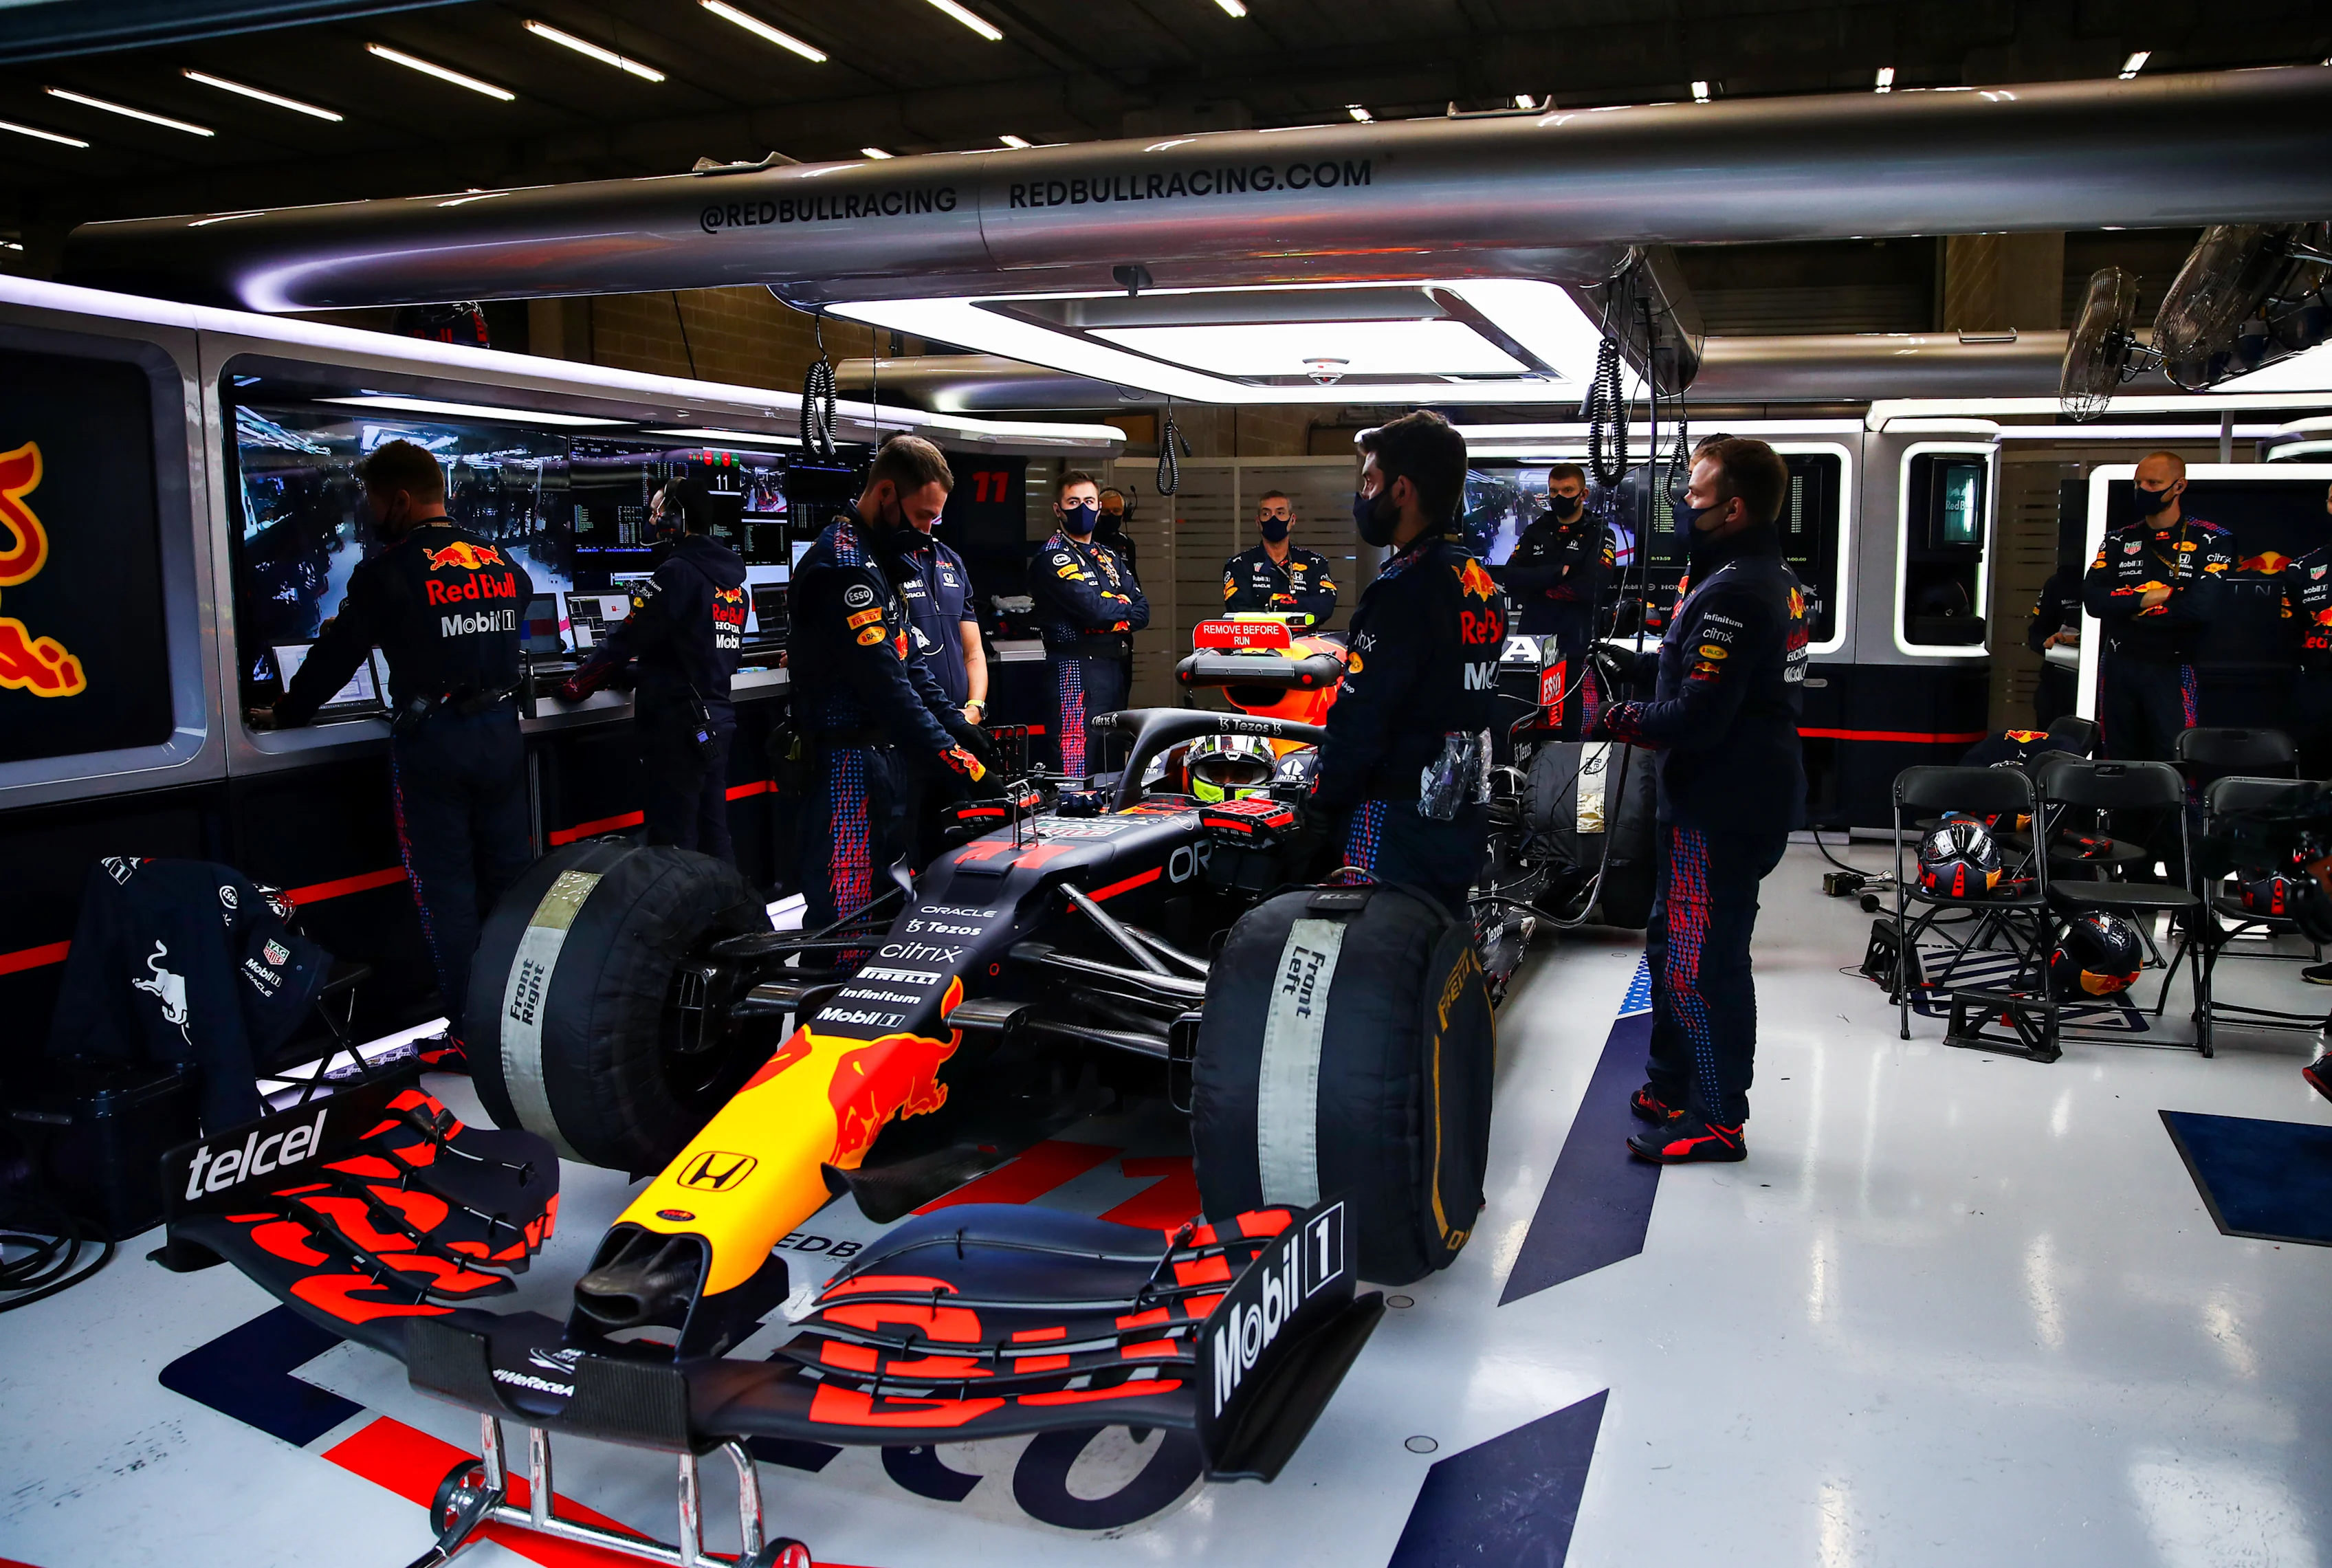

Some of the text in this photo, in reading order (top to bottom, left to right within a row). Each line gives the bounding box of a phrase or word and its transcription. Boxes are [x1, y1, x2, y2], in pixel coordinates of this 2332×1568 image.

[1009, 160, 1371, 208] REDBULLRACING.COM
[700, 187, 956, 234] @REDBULLRACING
[716, 474, 728, 490] 11
[972, 472, 1009, 503] 11
[425, 573, 516, 606] Red Bull
[441, 610, 500, 637] Mobil
[1204, 624, 1279, 634] REMOVE BEFORE
[1703, 612, 1743, 628] infinitum
[1234, 637, 1251, 645] RUN
[1702, 628, 1734, 643] citrix
[1232, 719, 1269, 733] Tezos
[954, 841, 1075, 869] 11
[920, 905, 998, 918] ORACLE
[927, 922, 982, 936] Tezos
[1486, 922, 1504, 945] Tezos
[269, 941, 287, 957] TAG
[879, 941, 963, 963] citrix
[245, 958, 274, 982] Mobil
[856, 966, 942, 985] PIRELLI
[1282, 946, 1310, 996] Left
[241, 968, 273, 997] ORACLE
[509, 958, 534, 1021] Front
[1296, 951, 1326, 1019] Front
[521, 964, 544, 1026] Right
[837, 987, 921, 1004] infinitum
[816, 1006, 882, 1026] Mobil
[185, 1108, 328, 1201] telcel
[1214, 1233, 1299, 1419] Mobil
